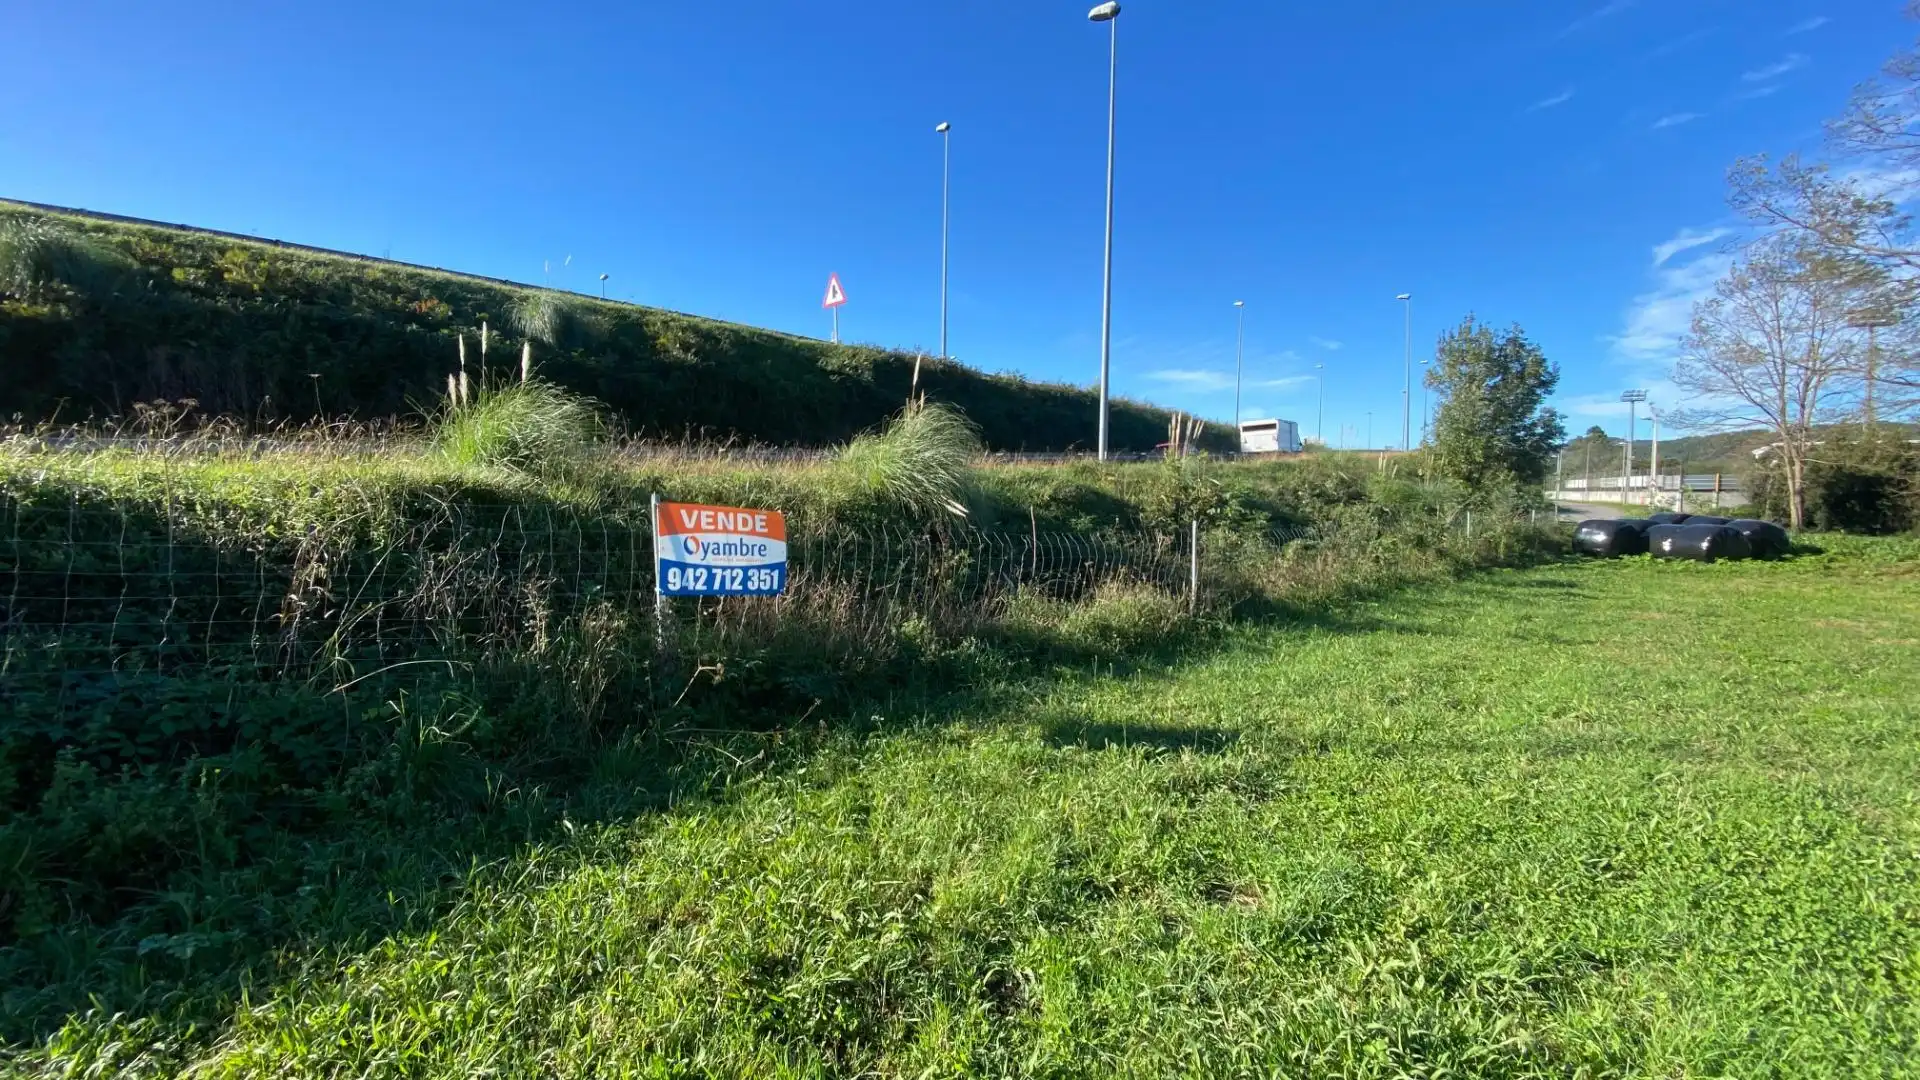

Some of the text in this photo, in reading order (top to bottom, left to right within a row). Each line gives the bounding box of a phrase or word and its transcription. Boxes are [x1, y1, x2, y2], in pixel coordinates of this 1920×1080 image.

[680, 509, 768, 533] VENDE
[683, 535, 767, 561] Oyambre
[667, 567, 779, 591] 942 712 351
